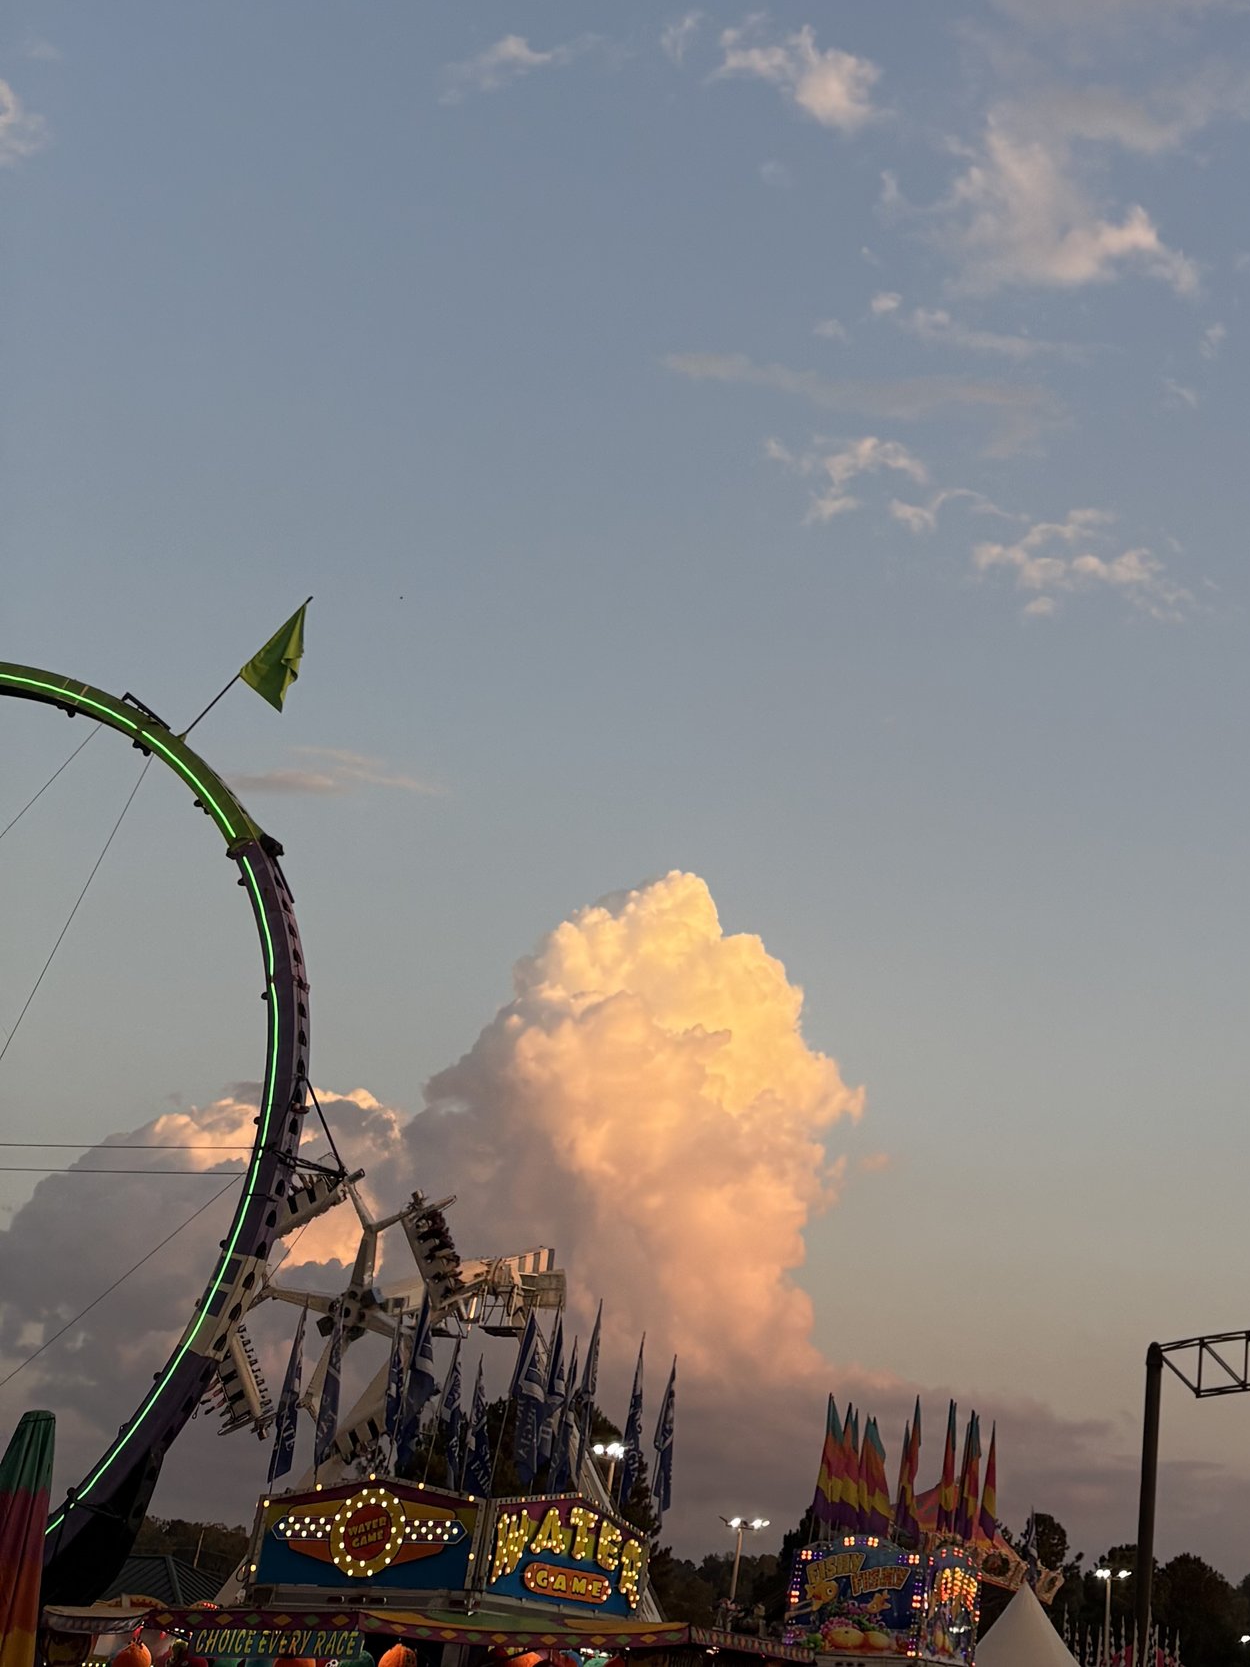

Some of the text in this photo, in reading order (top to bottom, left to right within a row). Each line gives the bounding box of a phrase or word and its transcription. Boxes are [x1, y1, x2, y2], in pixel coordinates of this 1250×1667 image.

[348, 1516, 387, 1536] WATER
[351, 1529, 384, 1548] GAME
[490, 1506, 642, 1609] WATER
[535, 1570, 602, 1597] GAME
[195, 1629, 359, 1657] CHOICE EVERY RACE
